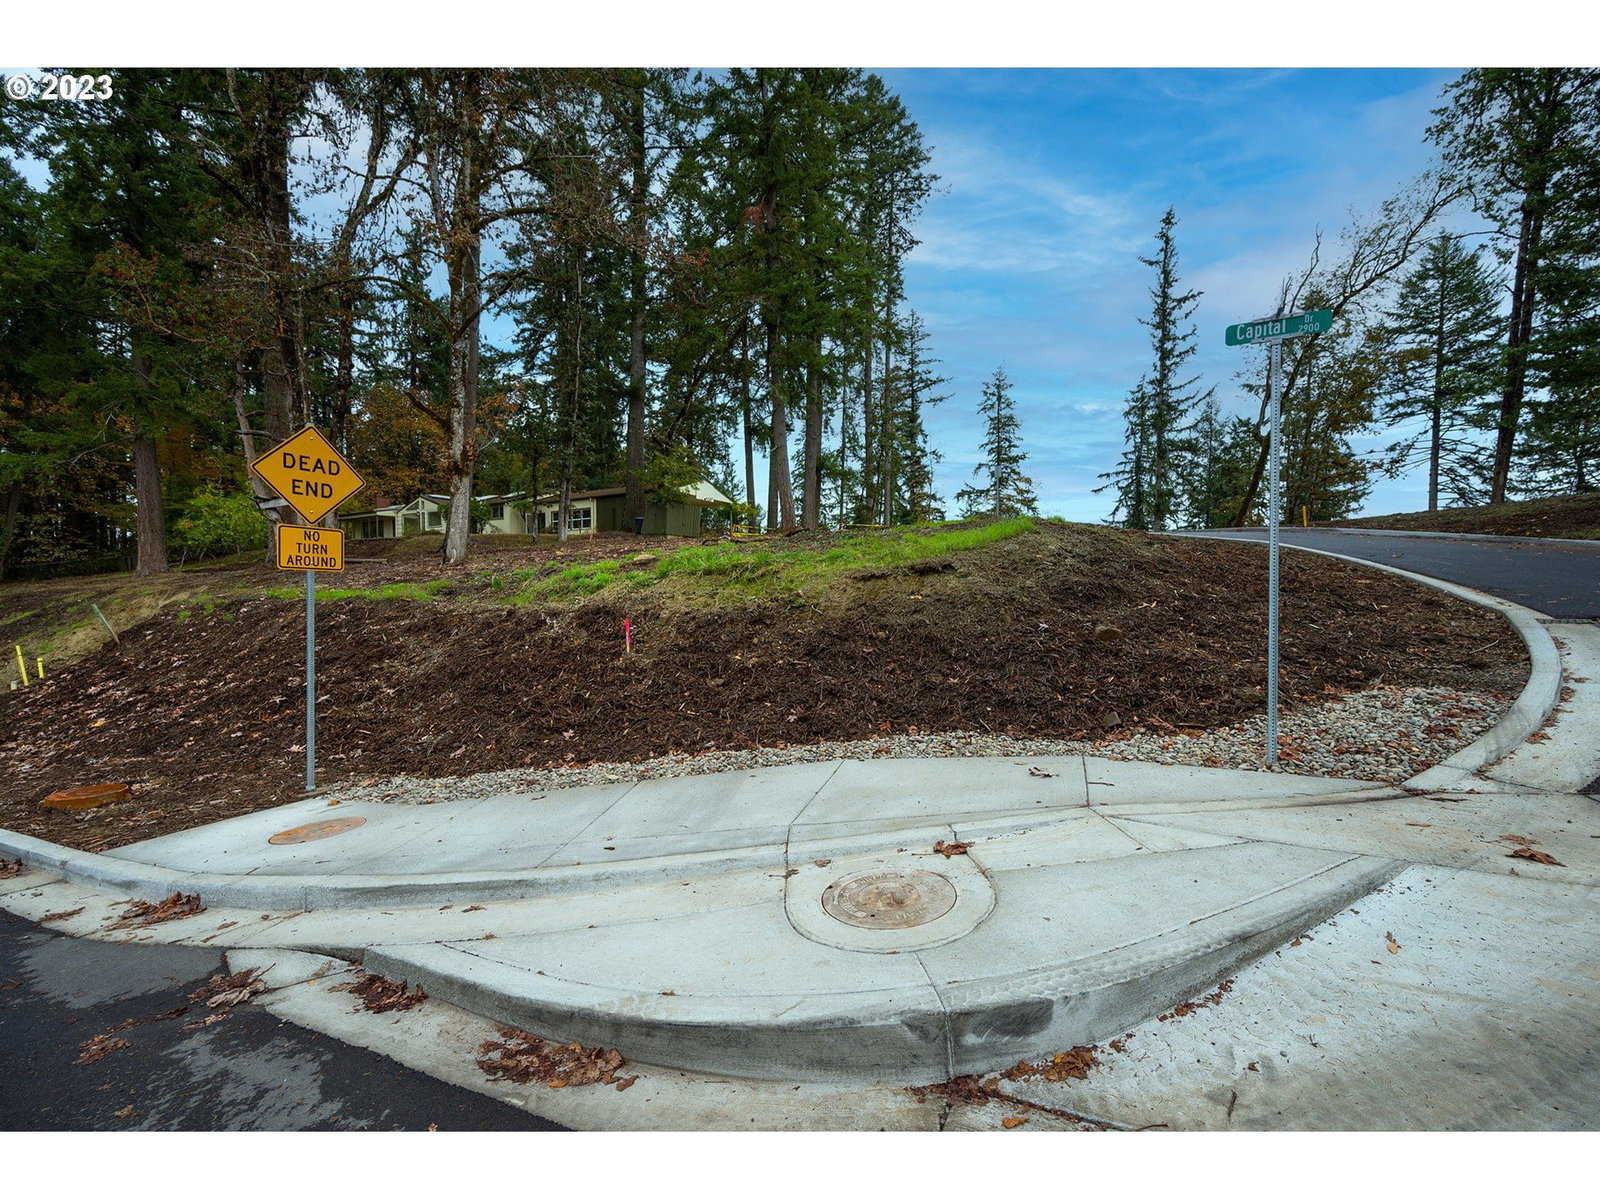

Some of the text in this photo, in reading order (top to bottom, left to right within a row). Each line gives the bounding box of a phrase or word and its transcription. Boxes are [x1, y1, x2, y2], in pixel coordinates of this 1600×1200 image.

[1237, 314, 1314, 340] Capital Dr
[1298, 322, 1320, 333] 2900
[283, 453, 341, 475] DEAD
[292, 479, 333, 499] END
[304, 530, 320, 541] NO
[296, 542, 328, 555] TURN
[286, 555, 337, 568] AROUND
